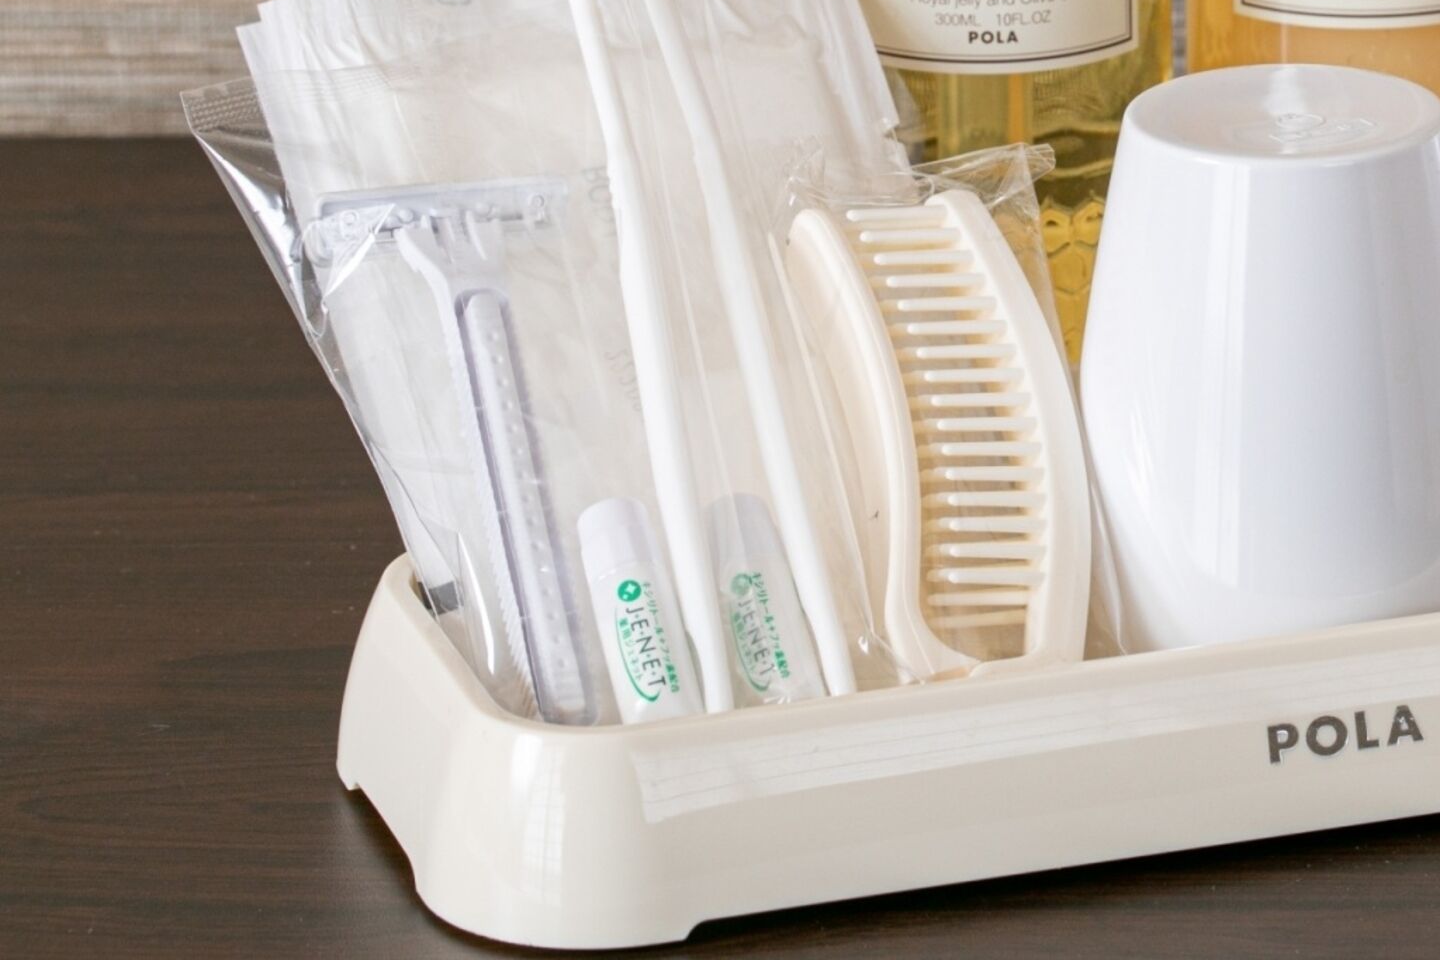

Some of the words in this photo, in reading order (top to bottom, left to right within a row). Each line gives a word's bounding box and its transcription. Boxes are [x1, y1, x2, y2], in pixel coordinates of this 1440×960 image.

[934, 13, 981, 27] 300ML
[968, 31, 1019, 44] POLA
[1267, 704, 1424, 765] POLA
